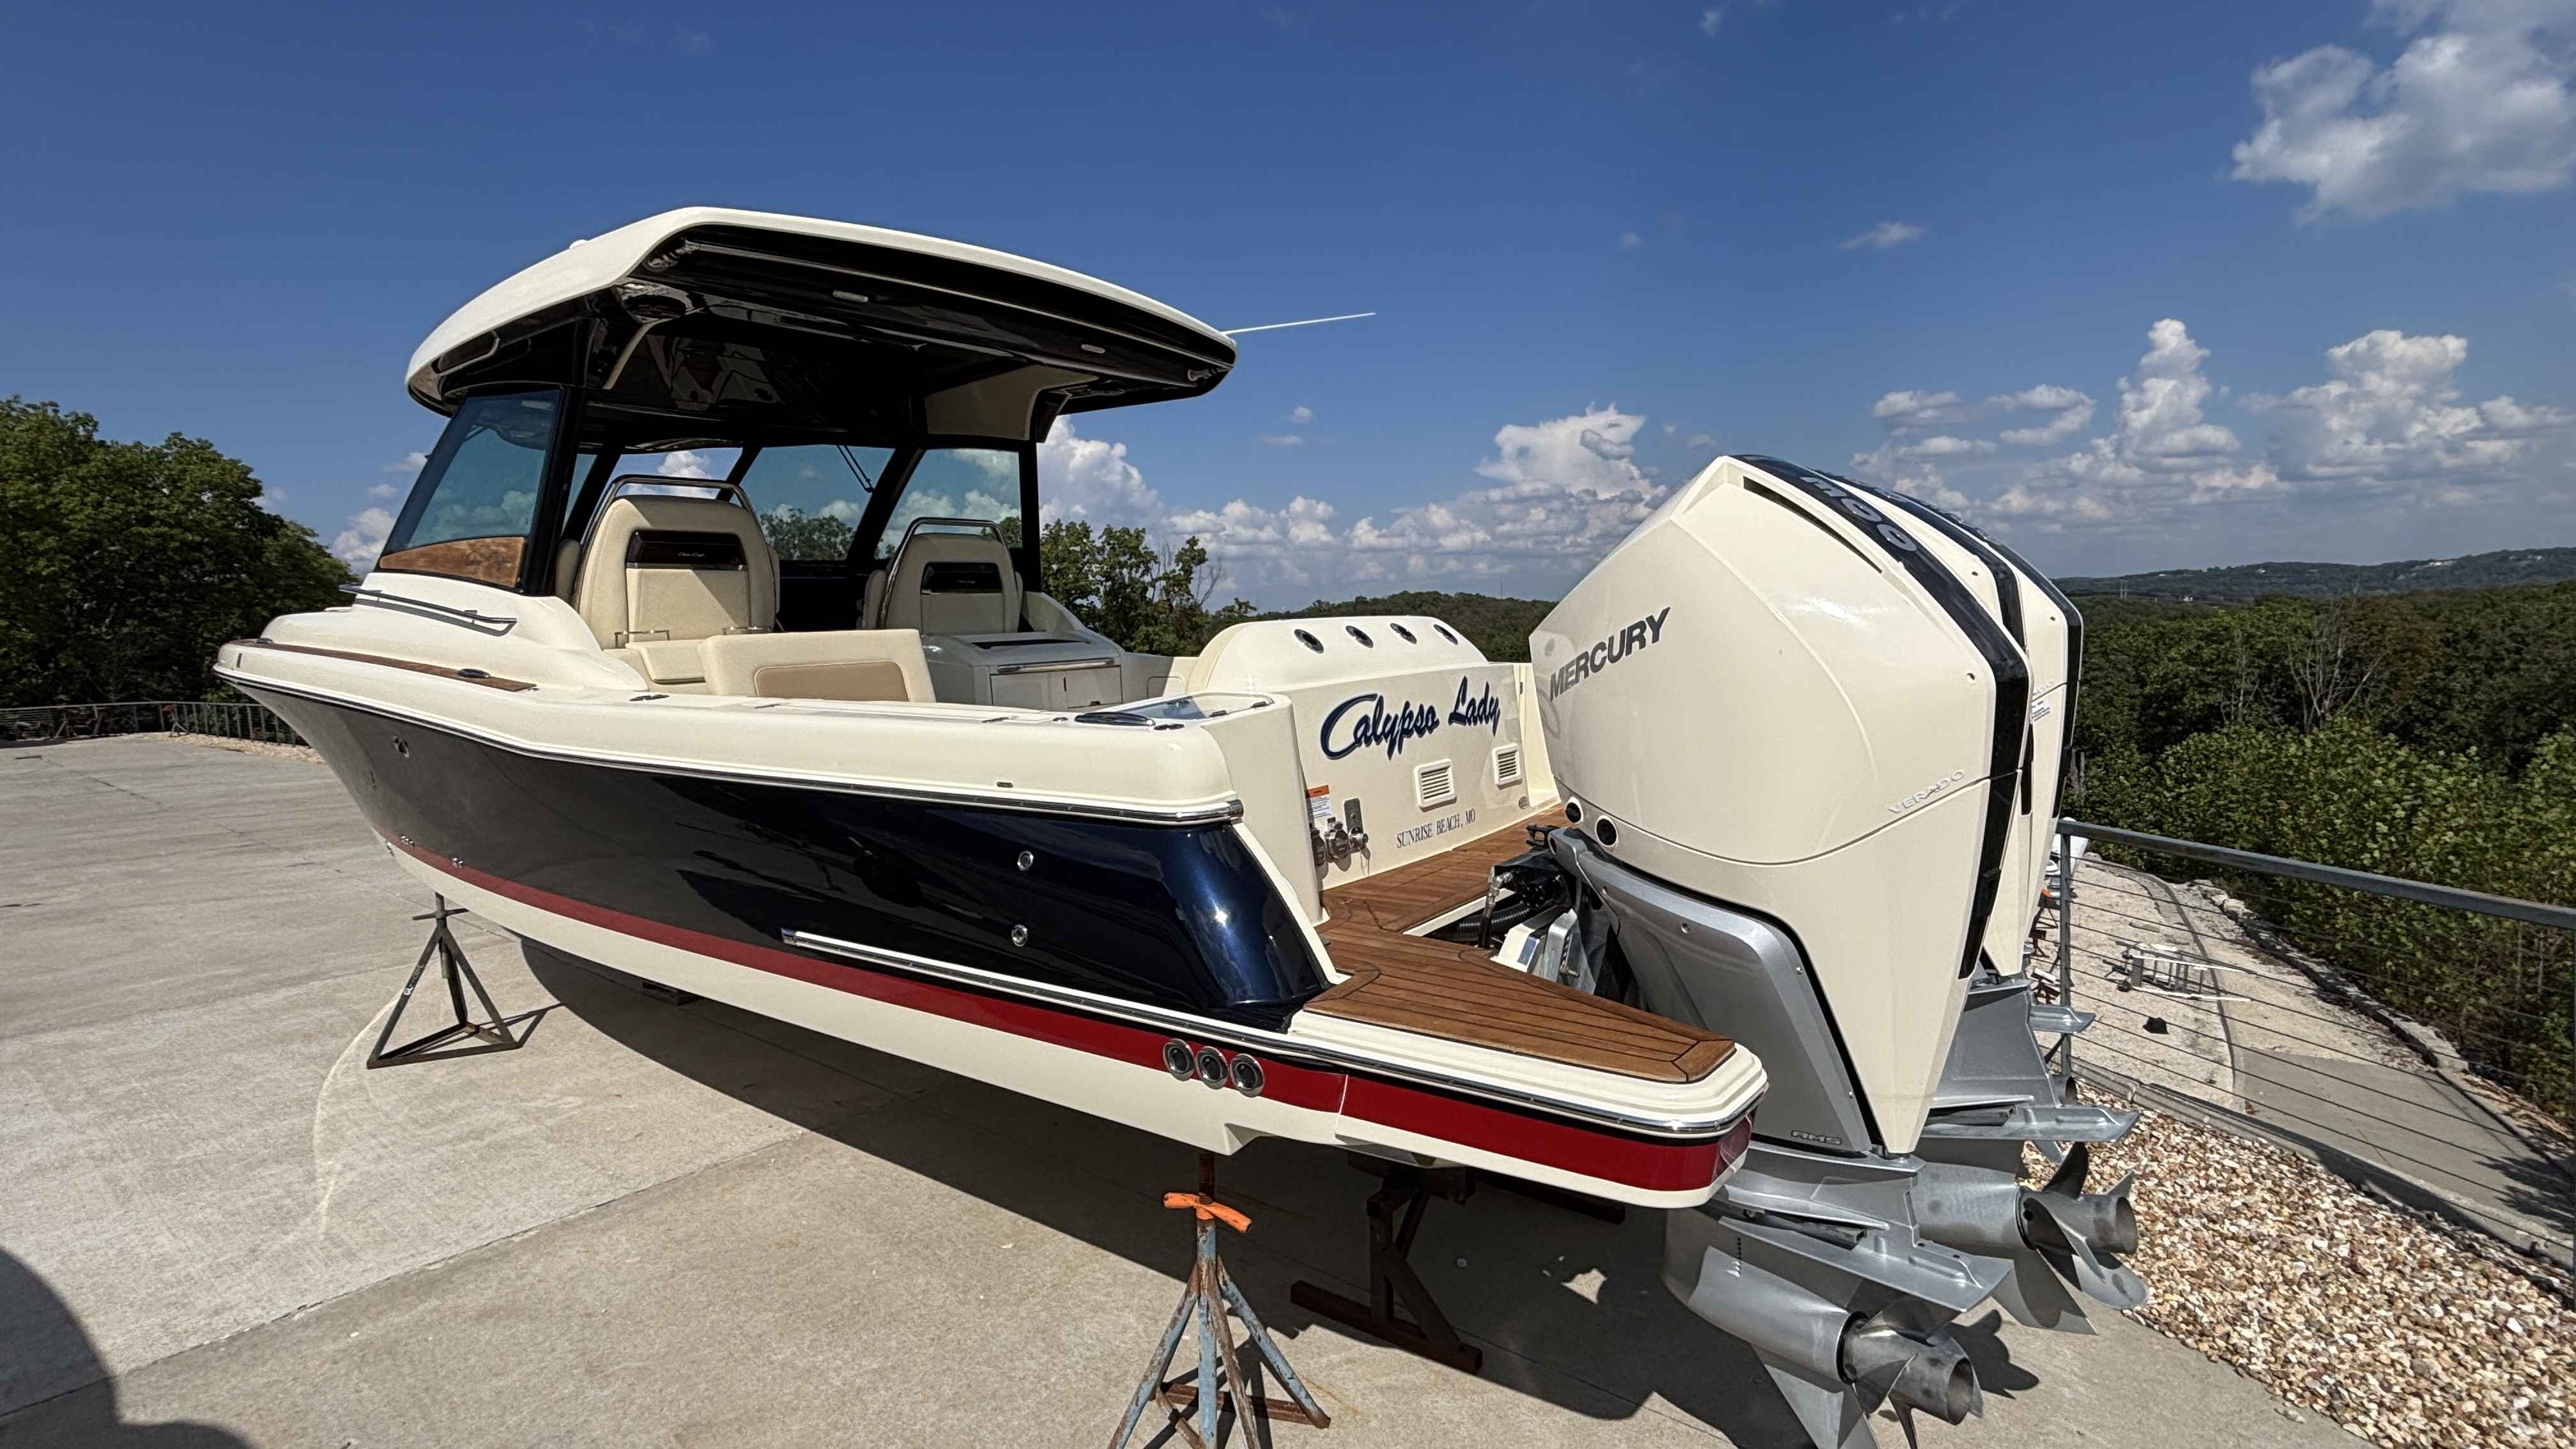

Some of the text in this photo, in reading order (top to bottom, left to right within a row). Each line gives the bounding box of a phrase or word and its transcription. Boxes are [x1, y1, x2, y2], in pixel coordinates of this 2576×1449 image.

[1549, 606, 1671, 702] MERCURY
[1320, 675, 1501, 761] Calypso Lady
[1888, 769, 1965, 814] VERADO
[1397, 808, 1476, 848] SUNRISE BEACH, MO
